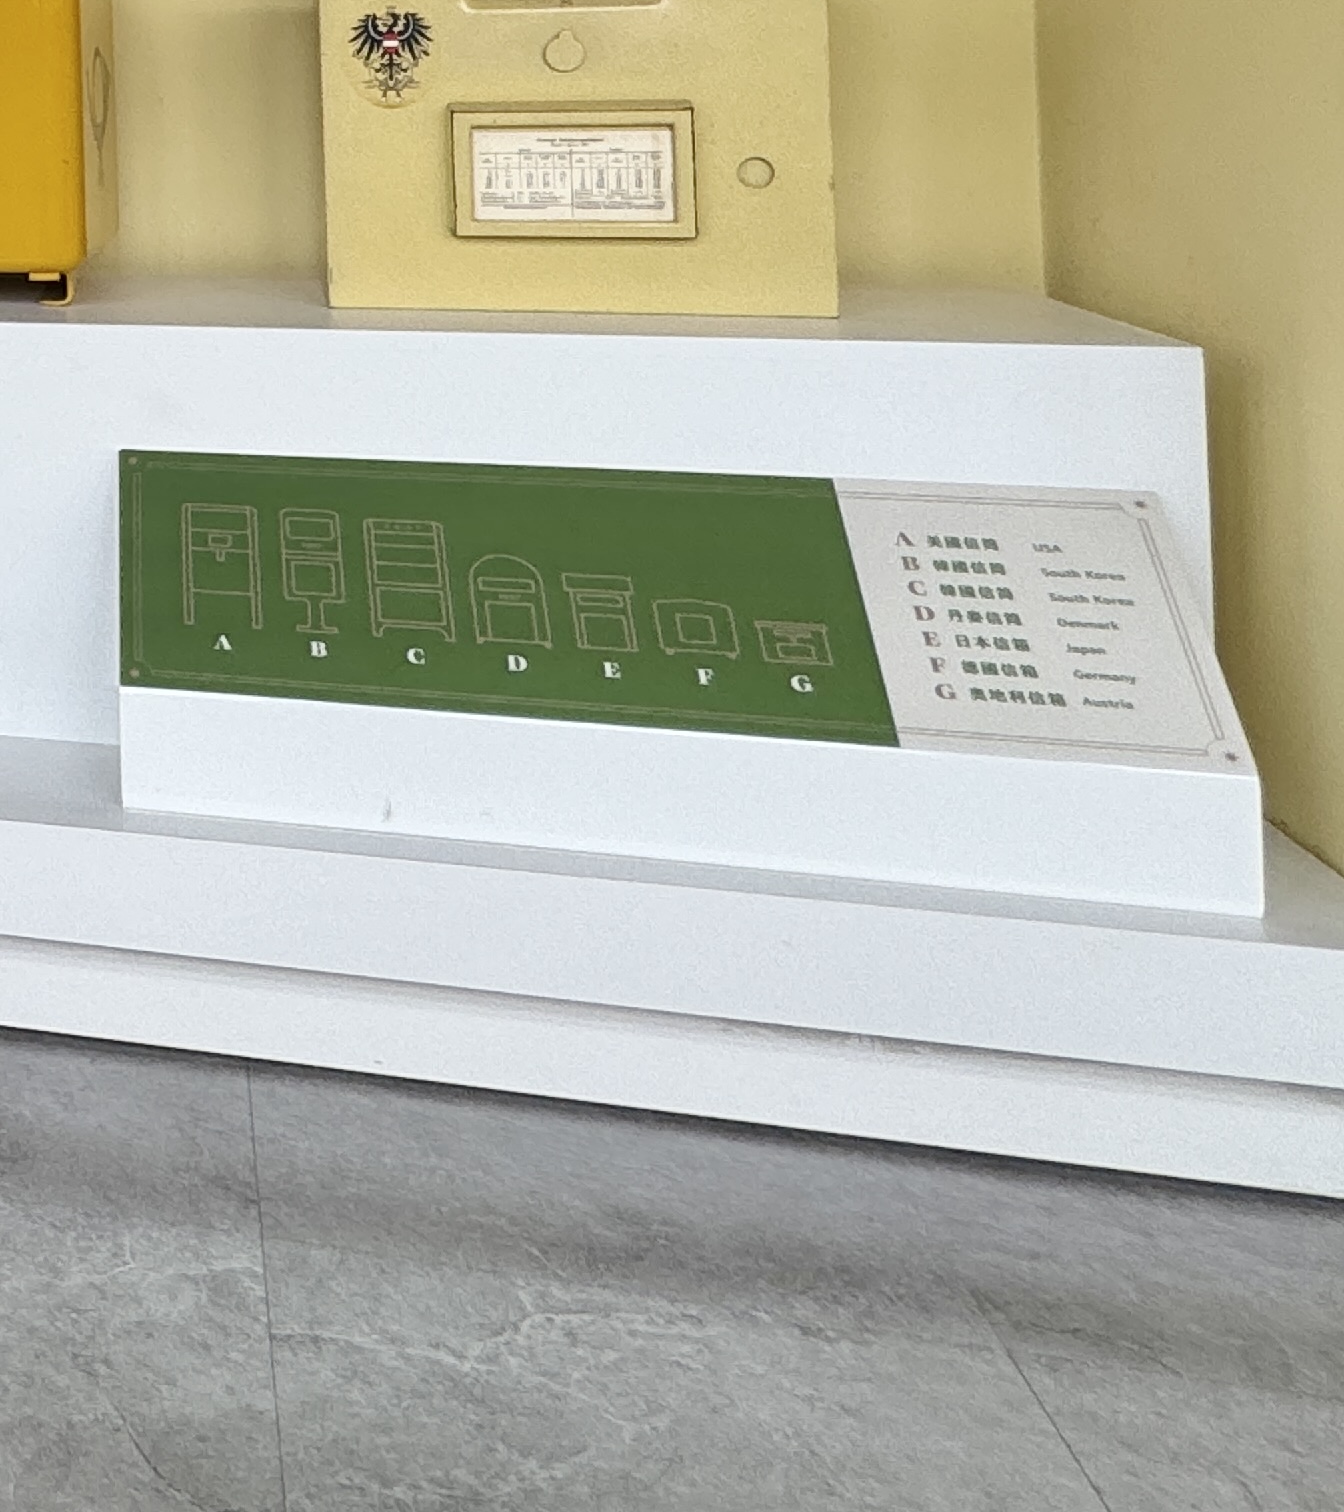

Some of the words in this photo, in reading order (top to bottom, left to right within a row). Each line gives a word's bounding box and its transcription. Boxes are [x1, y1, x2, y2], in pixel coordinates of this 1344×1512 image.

[895, 531, 916, 547] A
[1032, 542, 1063, 553] USA
[901, 556, 920, 571] B
[907, 580, 927, 597] C
[1049, 592, 1089, 603] South
[913, 605, 935, 621] D
[922, 631, 941, 648] E
[1066, 643, 1107, 655] Japan
[214, 635, 232, 650] A
[310, 641, 328, 657] B
[406, 647, 426, 665] C
[507, 654, 528, 672] D
[603, 662, 622, 679] E
[696, 668, 714, 685] F
[790, 675, 814, 693] G
[929, 657, 946, 673] F
[1073, 669, 1136, 685] Germany
[934, 683, 956, 700] G
[1083, 696, 1134, 709] Austria
